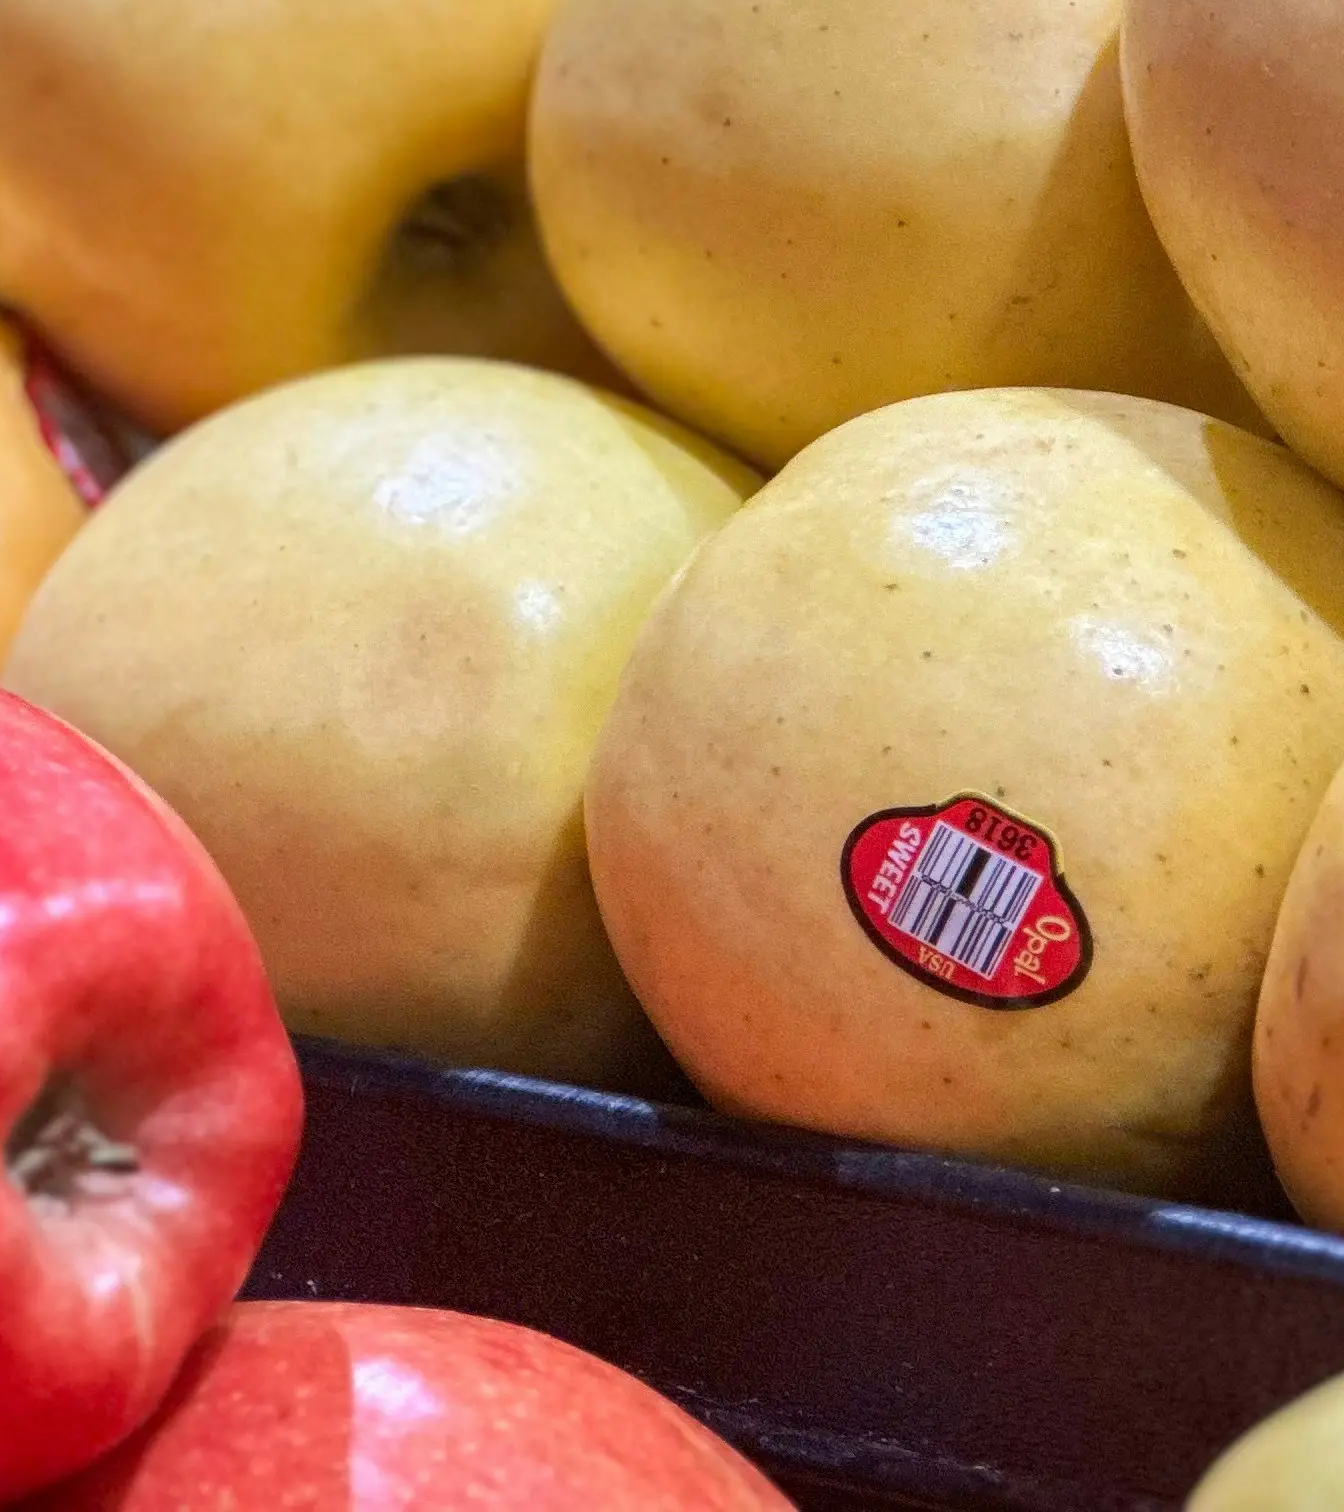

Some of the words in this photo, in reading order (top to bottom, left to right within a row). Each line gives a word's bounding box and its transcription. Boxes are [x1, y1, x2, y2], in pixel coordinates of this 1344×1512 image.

[965, 807, 1037, 860] 3618
[867, 822, 921, 915] SWEET
[918, 946, 955, 980] USA
[1013, 915, 1071, 984] Opal
